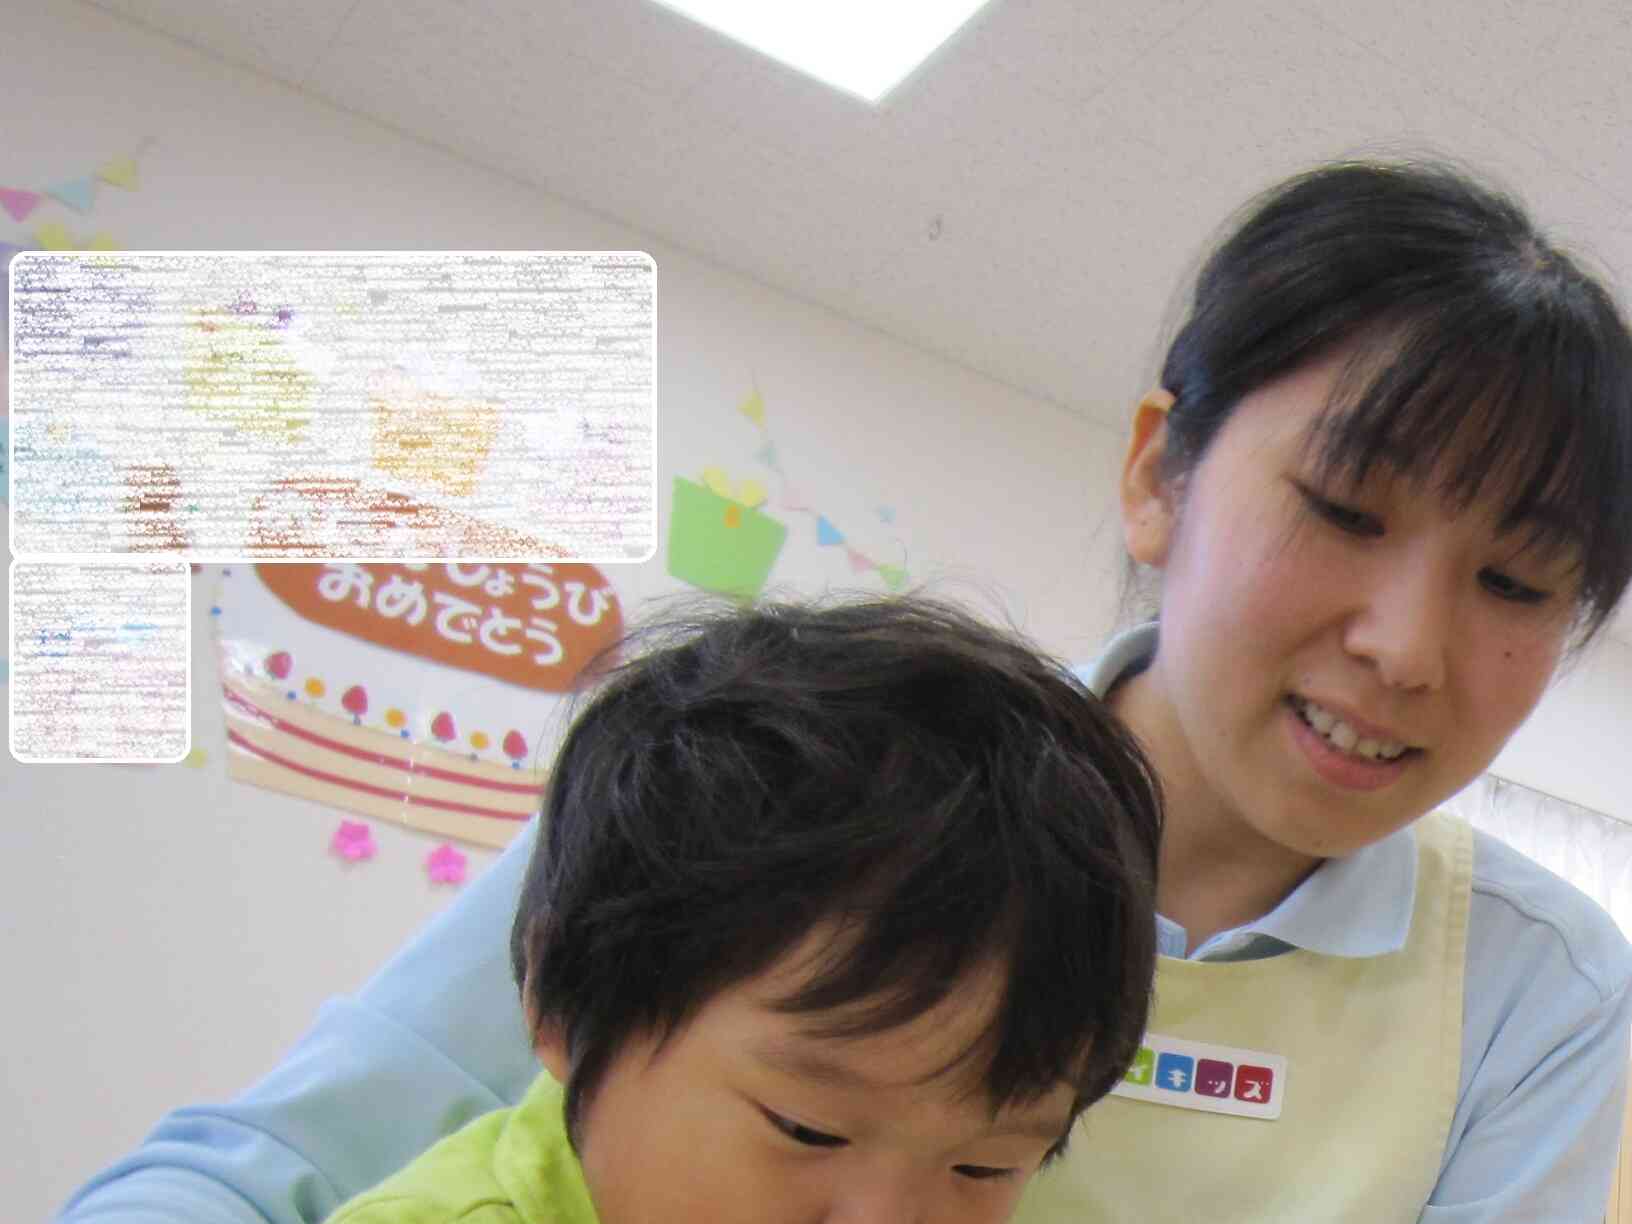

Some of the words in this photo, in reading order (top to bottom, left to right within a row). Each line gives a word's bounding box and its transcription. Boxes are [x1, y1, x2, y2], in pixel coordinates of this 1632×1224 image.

[317, 563, 565, 665] おめでとう
